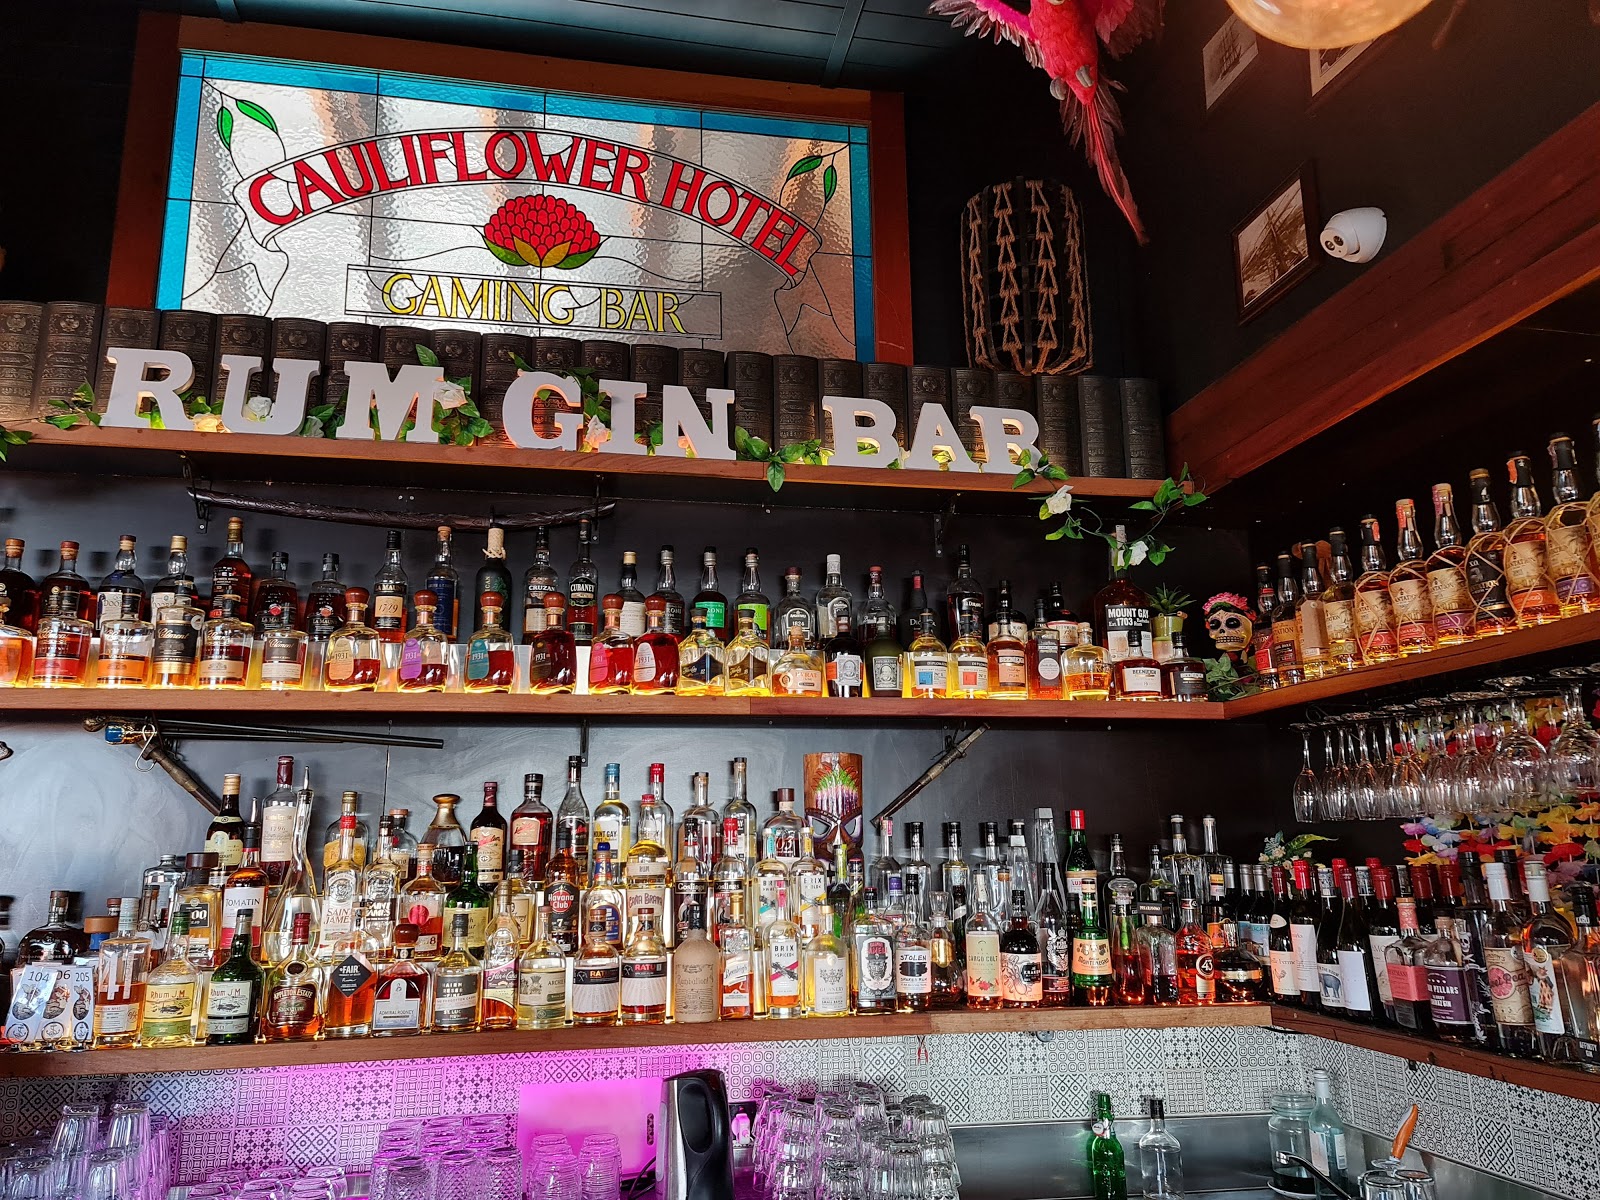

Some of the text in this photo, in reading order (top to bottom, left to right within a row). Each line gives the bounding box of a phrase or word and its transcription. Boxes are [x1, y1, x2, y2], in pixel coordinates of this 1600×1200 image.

[248, 131, 816, 277] CAULIFLOWER HOTEL
[383, 273, 688, 335] GAMING BAR
[99, 347, 1043, 475] RUM GIN BAR
[1108, 608, 1137, 618] MOUNT
[1116, 618, 1134, 627] 1703
[638, 656, 651, 664] 1931
[225, 898, 260, 907] TOMATIN
[548, 893, 575, 902] Havana
[551, 901, 569, 910] Club
[326, 908, 350, 917] SAIN
[323, 915, 350, 925] JAME
[557, 917, 563, 927] 7
[342, 965, 359, 974] FAIR
[1201, 959, 1213, 971] 43
[27, 970, 50, 982] 104
[75, 972, 90, 982] 205
[210, 988, 226, 997] Rhum
[273, 987, 314, 1000] APPLETON ESTATE
[1433, 984, 1459, 994] PILLARS
[150, 990, 170, 999] Rhum
